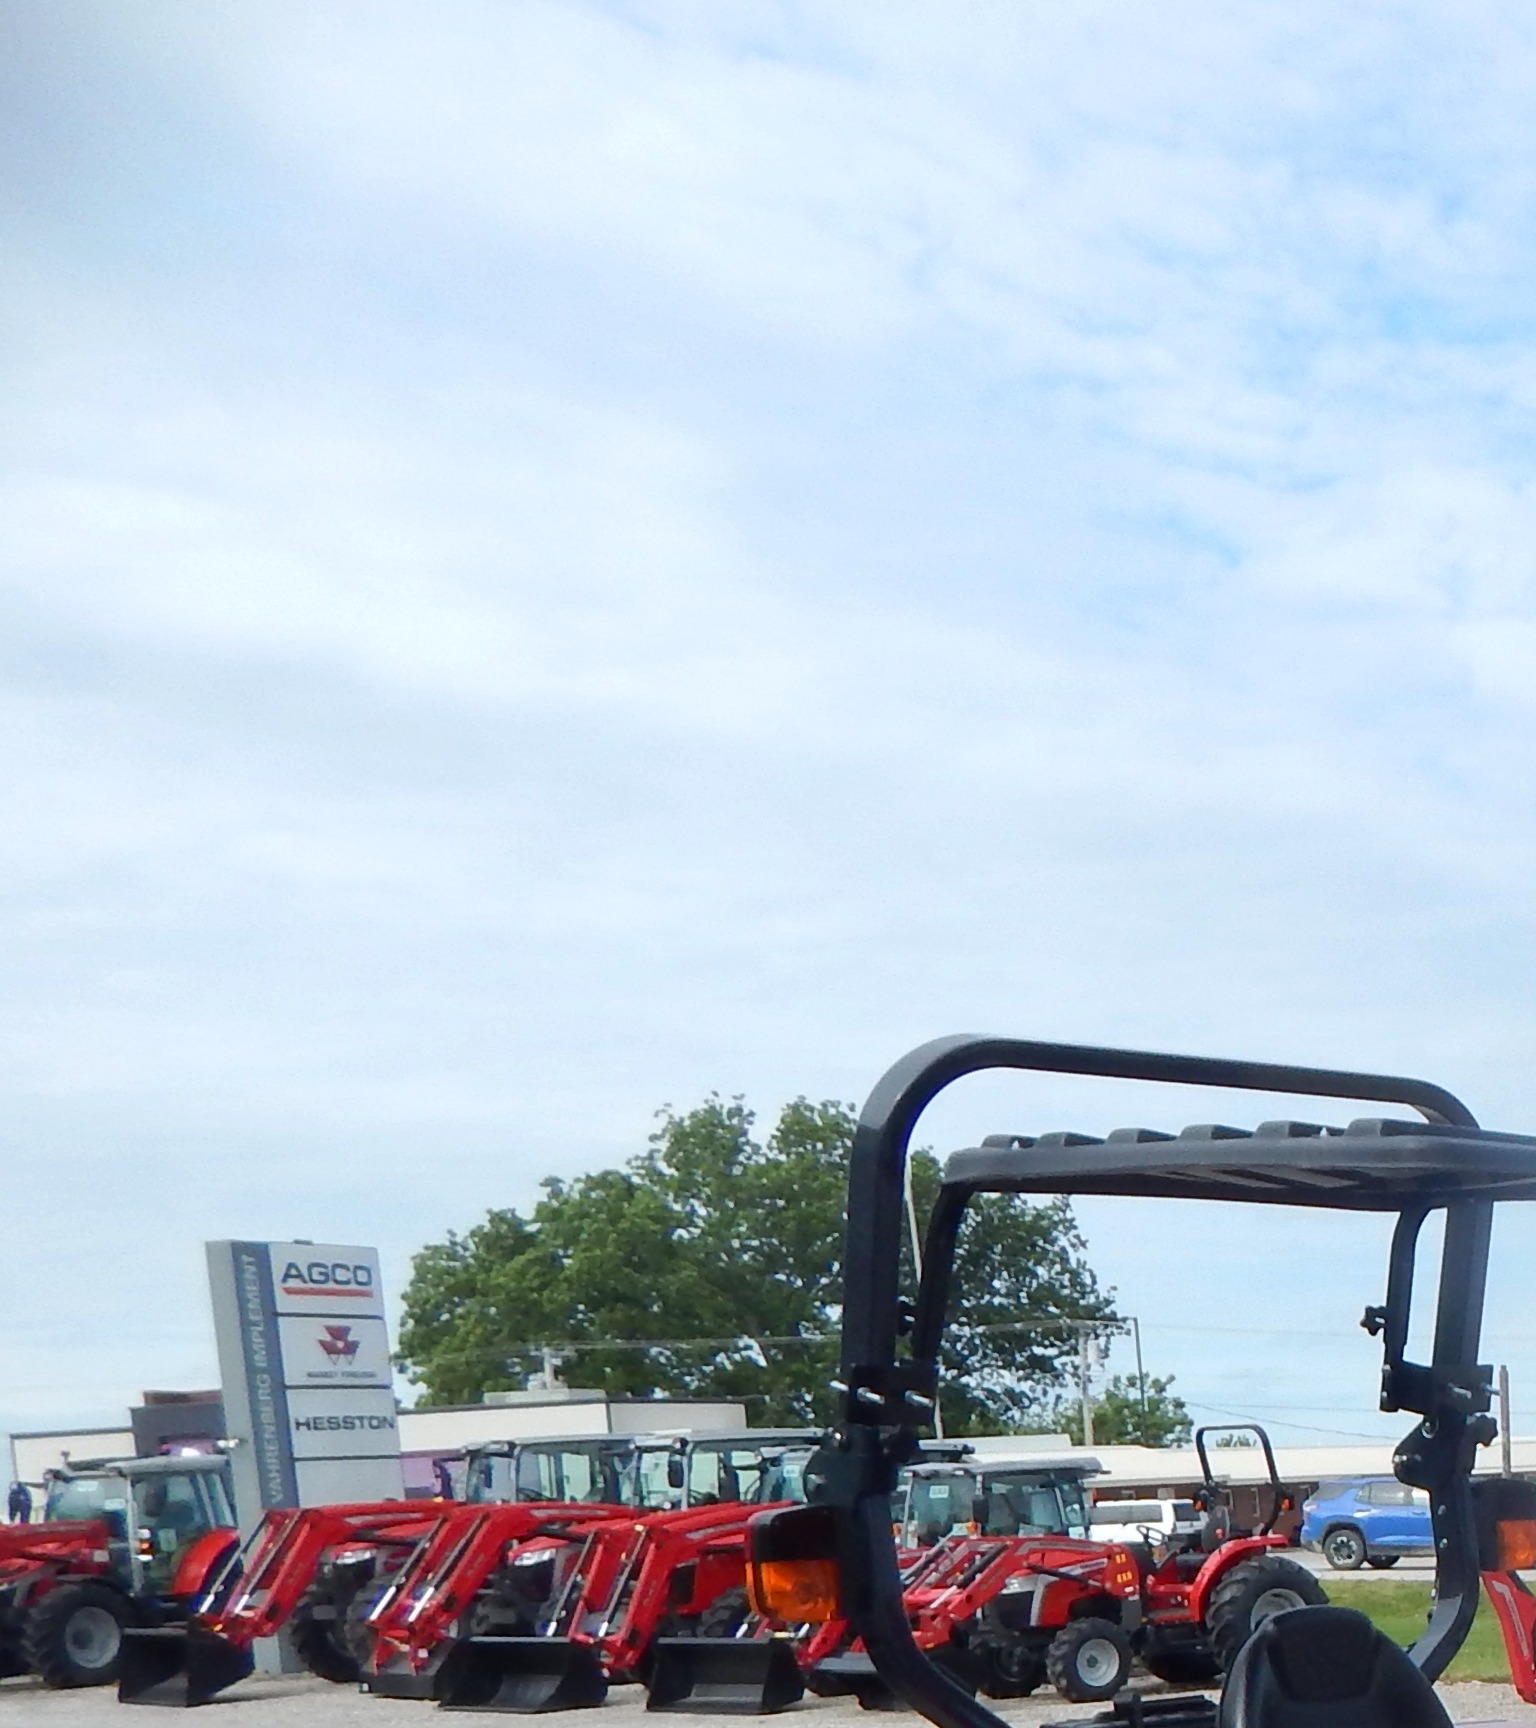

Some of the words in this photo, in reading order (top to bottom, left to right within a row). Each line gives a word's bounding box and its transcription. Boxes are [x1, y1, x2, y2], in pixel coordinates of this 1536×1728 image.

[281, 1261, 373, 1287] AGCO
[241, 1254, 268, 1368] IMPLEMENT
[295, 1416, 395, 1431] HESSTON
